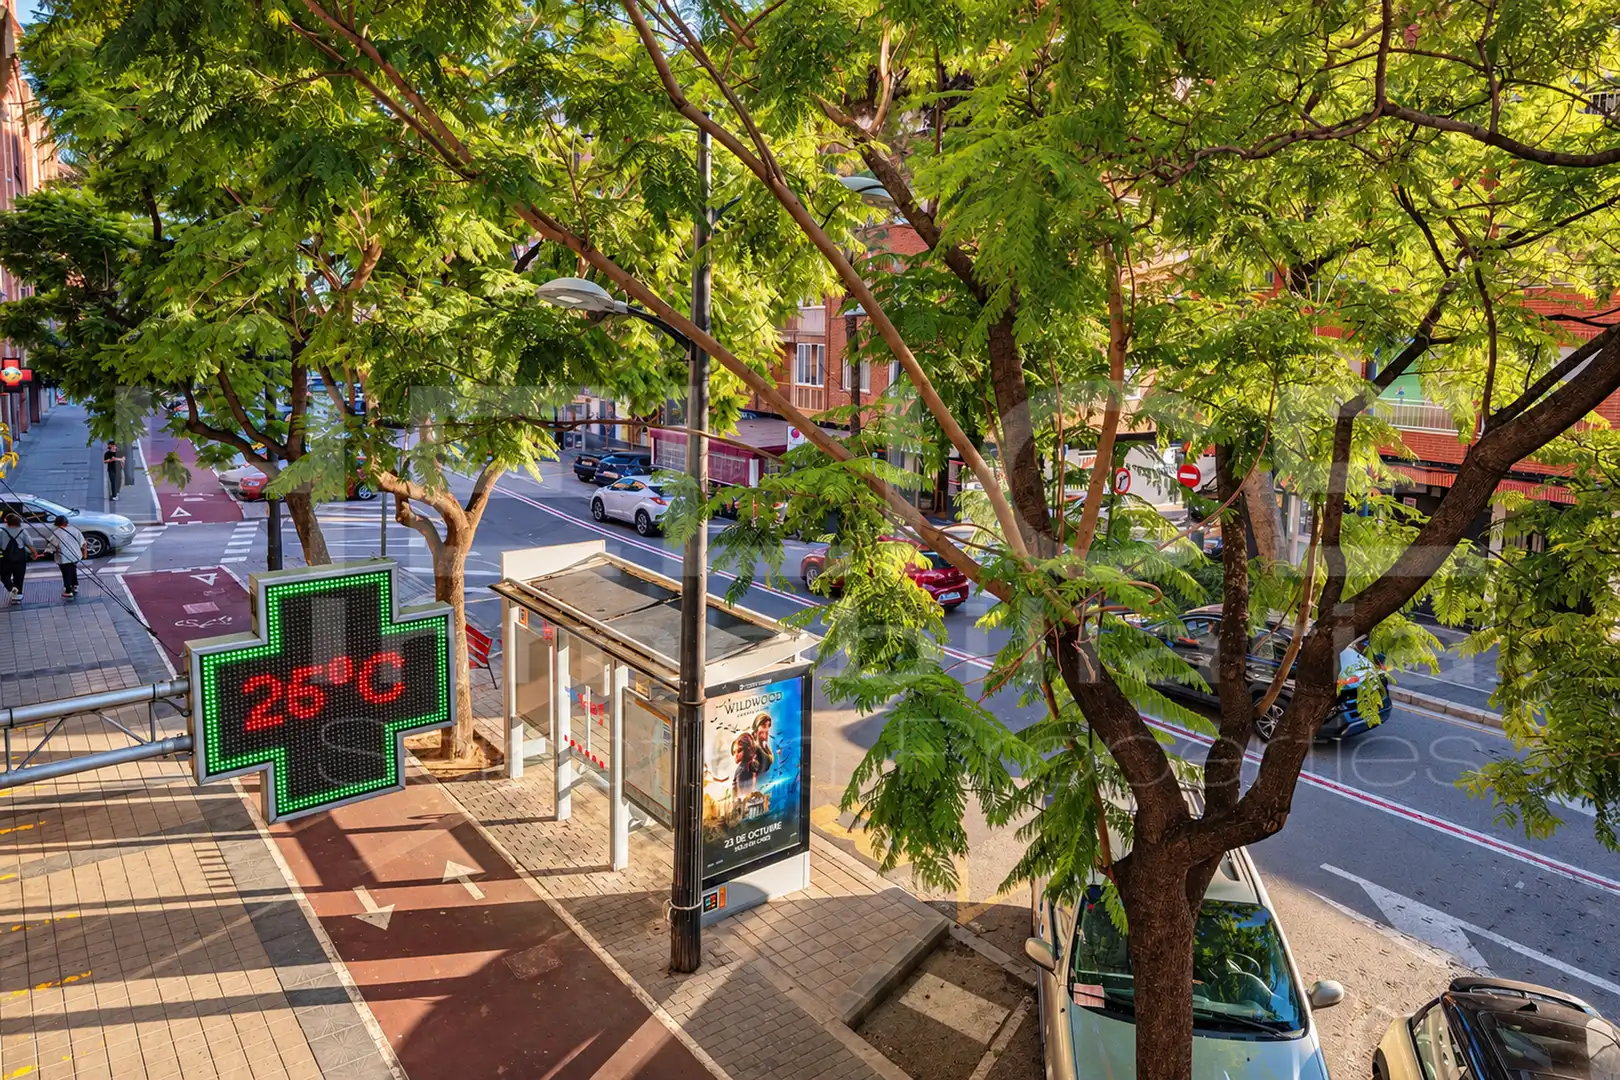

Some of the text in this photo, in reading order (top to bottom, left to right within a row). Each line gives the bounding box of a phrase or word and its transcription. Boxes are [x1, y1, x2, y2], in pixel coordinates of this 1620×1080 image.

[724, 691, 784, 715] WILDWOOD
[723, 837, 734, 849] 23
[735, 833, 747, 844] DE
